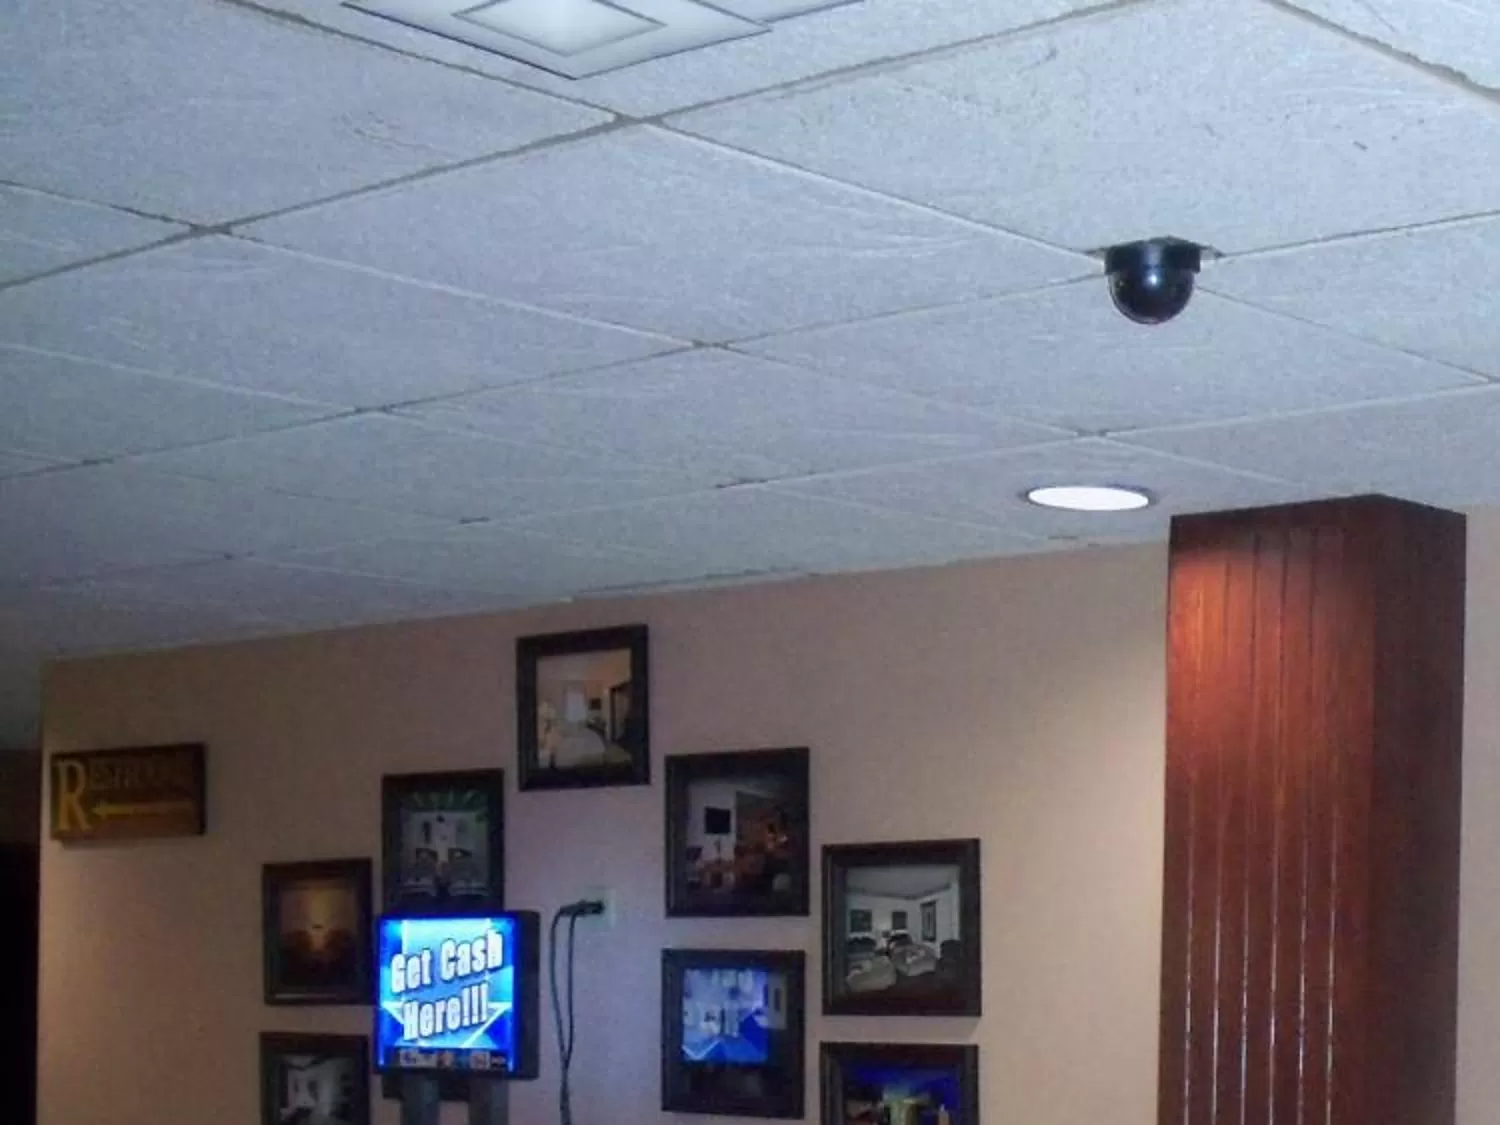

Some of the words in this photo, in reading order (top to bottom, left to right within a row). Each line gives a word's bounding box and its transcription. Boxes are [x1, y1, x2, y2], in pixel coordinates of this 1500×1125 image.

[391, 948, 431, 994] Get
[441, 929, 503, 982] Cash
[402, 981, 489, 1041] Here!!!
